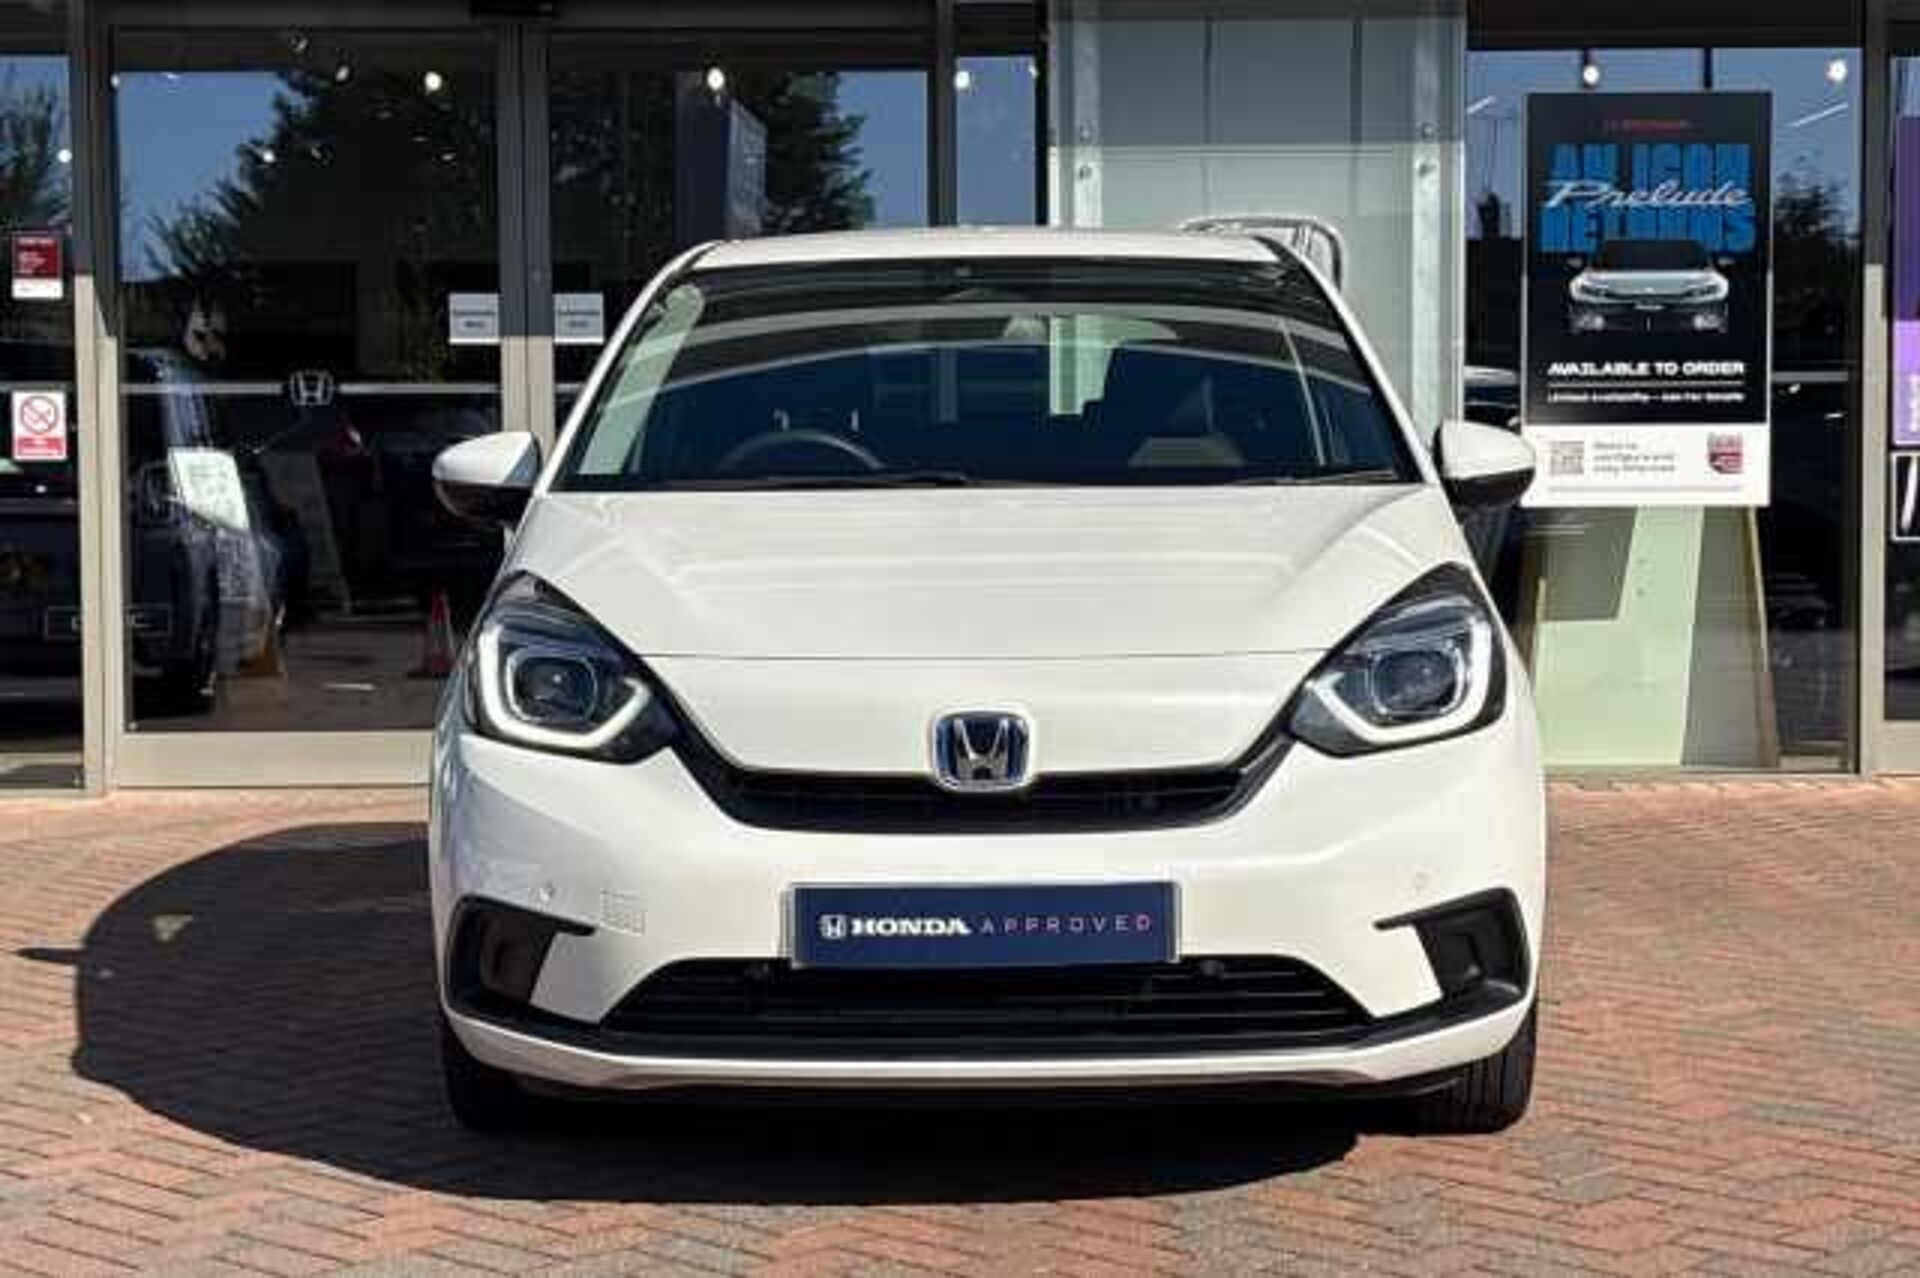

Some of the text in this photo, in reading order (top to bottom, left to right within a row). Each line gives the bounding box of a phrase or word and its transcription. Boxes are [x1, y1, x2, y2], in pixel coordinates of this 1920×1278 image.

[1543, 179, 1753, 208] Prelude
[1547, 361, 1744, 376] AVAILABLE TO ORDER
[851, 915, 970, 936] HONDA
[979, 912, 1152, 934] APPROVED
